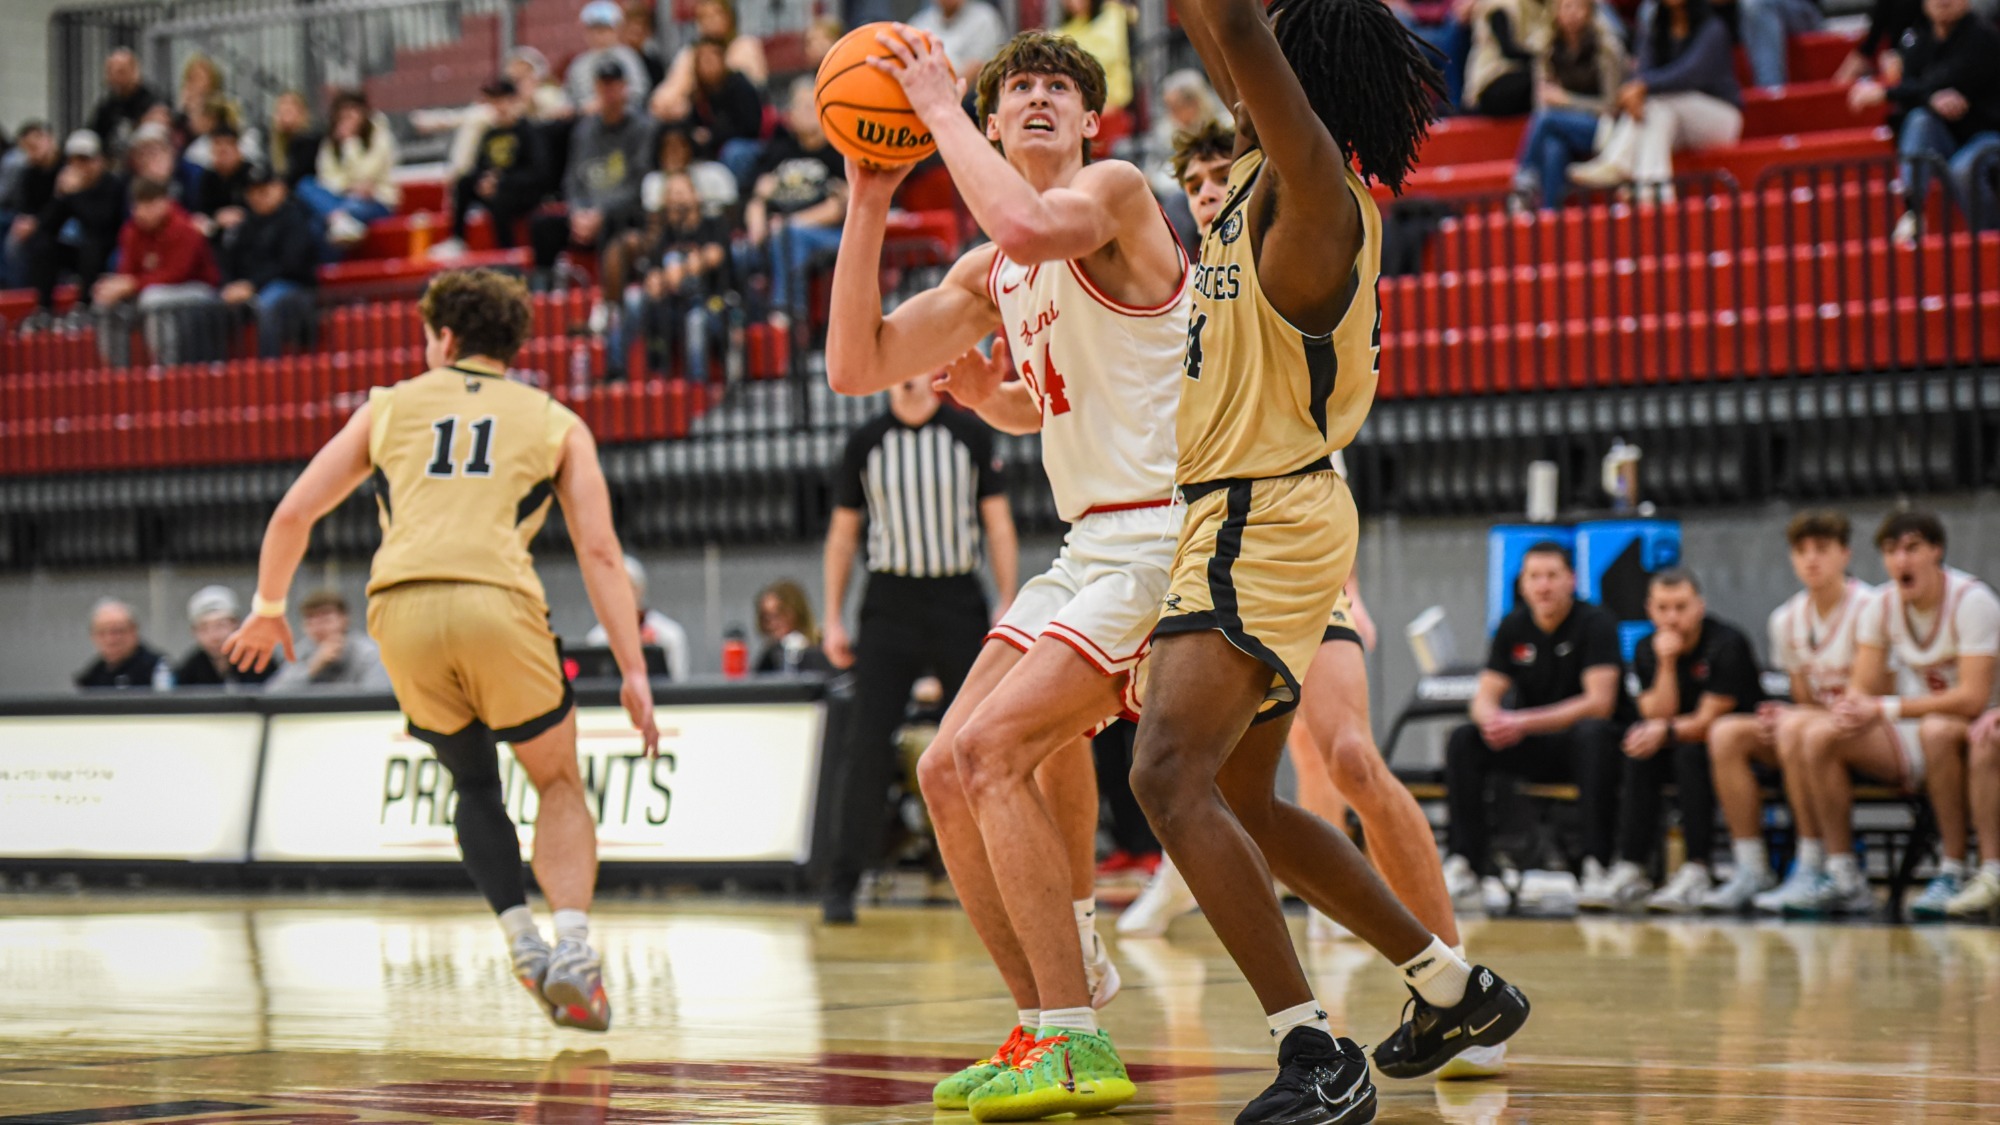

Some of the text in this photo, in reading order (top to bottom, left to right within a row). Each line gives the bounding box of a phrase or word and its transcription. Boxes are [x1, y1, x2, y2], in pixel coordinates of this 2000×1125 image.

[857, 116, 933, 148] Wilso
[426, 415, 497, 479] 11
[379, 753, 676, 826] PRINTS
